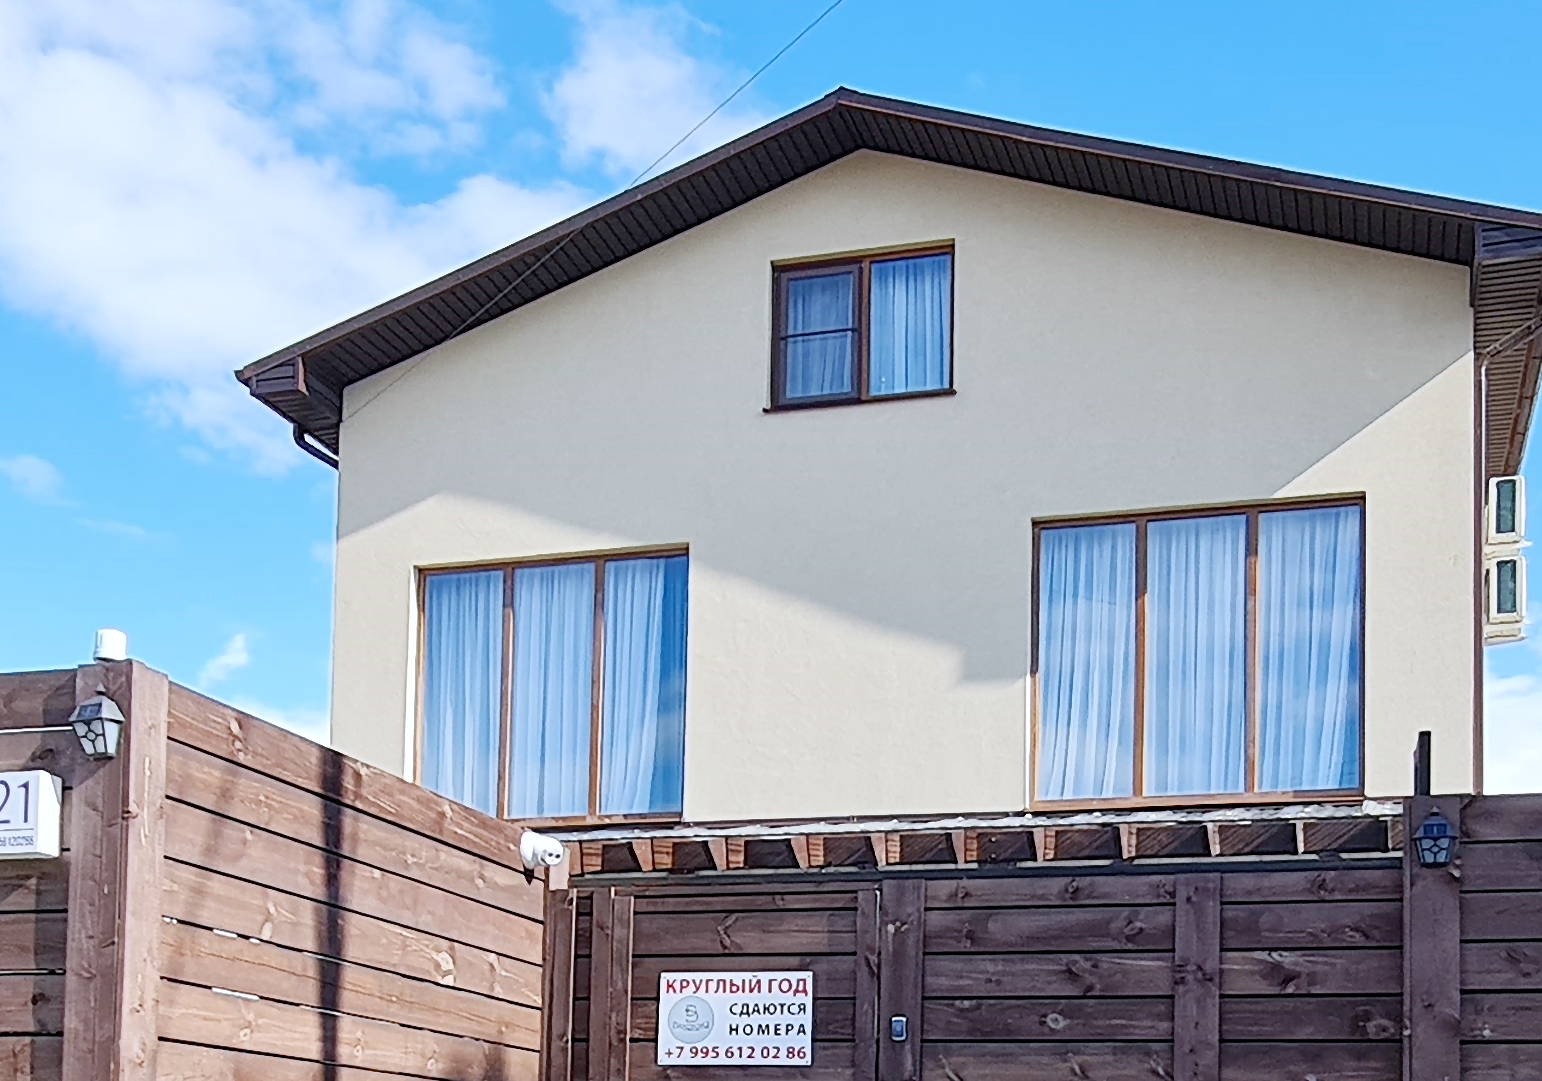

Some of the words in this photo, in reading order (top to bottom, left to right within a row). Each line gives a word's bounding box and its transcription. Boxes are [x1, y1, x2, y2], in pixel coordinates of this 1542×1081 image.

[666, 974, 762, 994] КРУГЛЫЙ
[767, 978, 809, 997] ГОД
[729, 1003, 807, 1018] СДАЮТСЯ
[729, 1023, 807, 1036] НОМЕРА
[665, 1046, 685, 1059] +7
[689, 1046, 719, 1059] 995
[724, 1046, 755, 1059] 612
[760, 1046, 781, 1059] 02
[786, 1046, 807, 1059] 86
